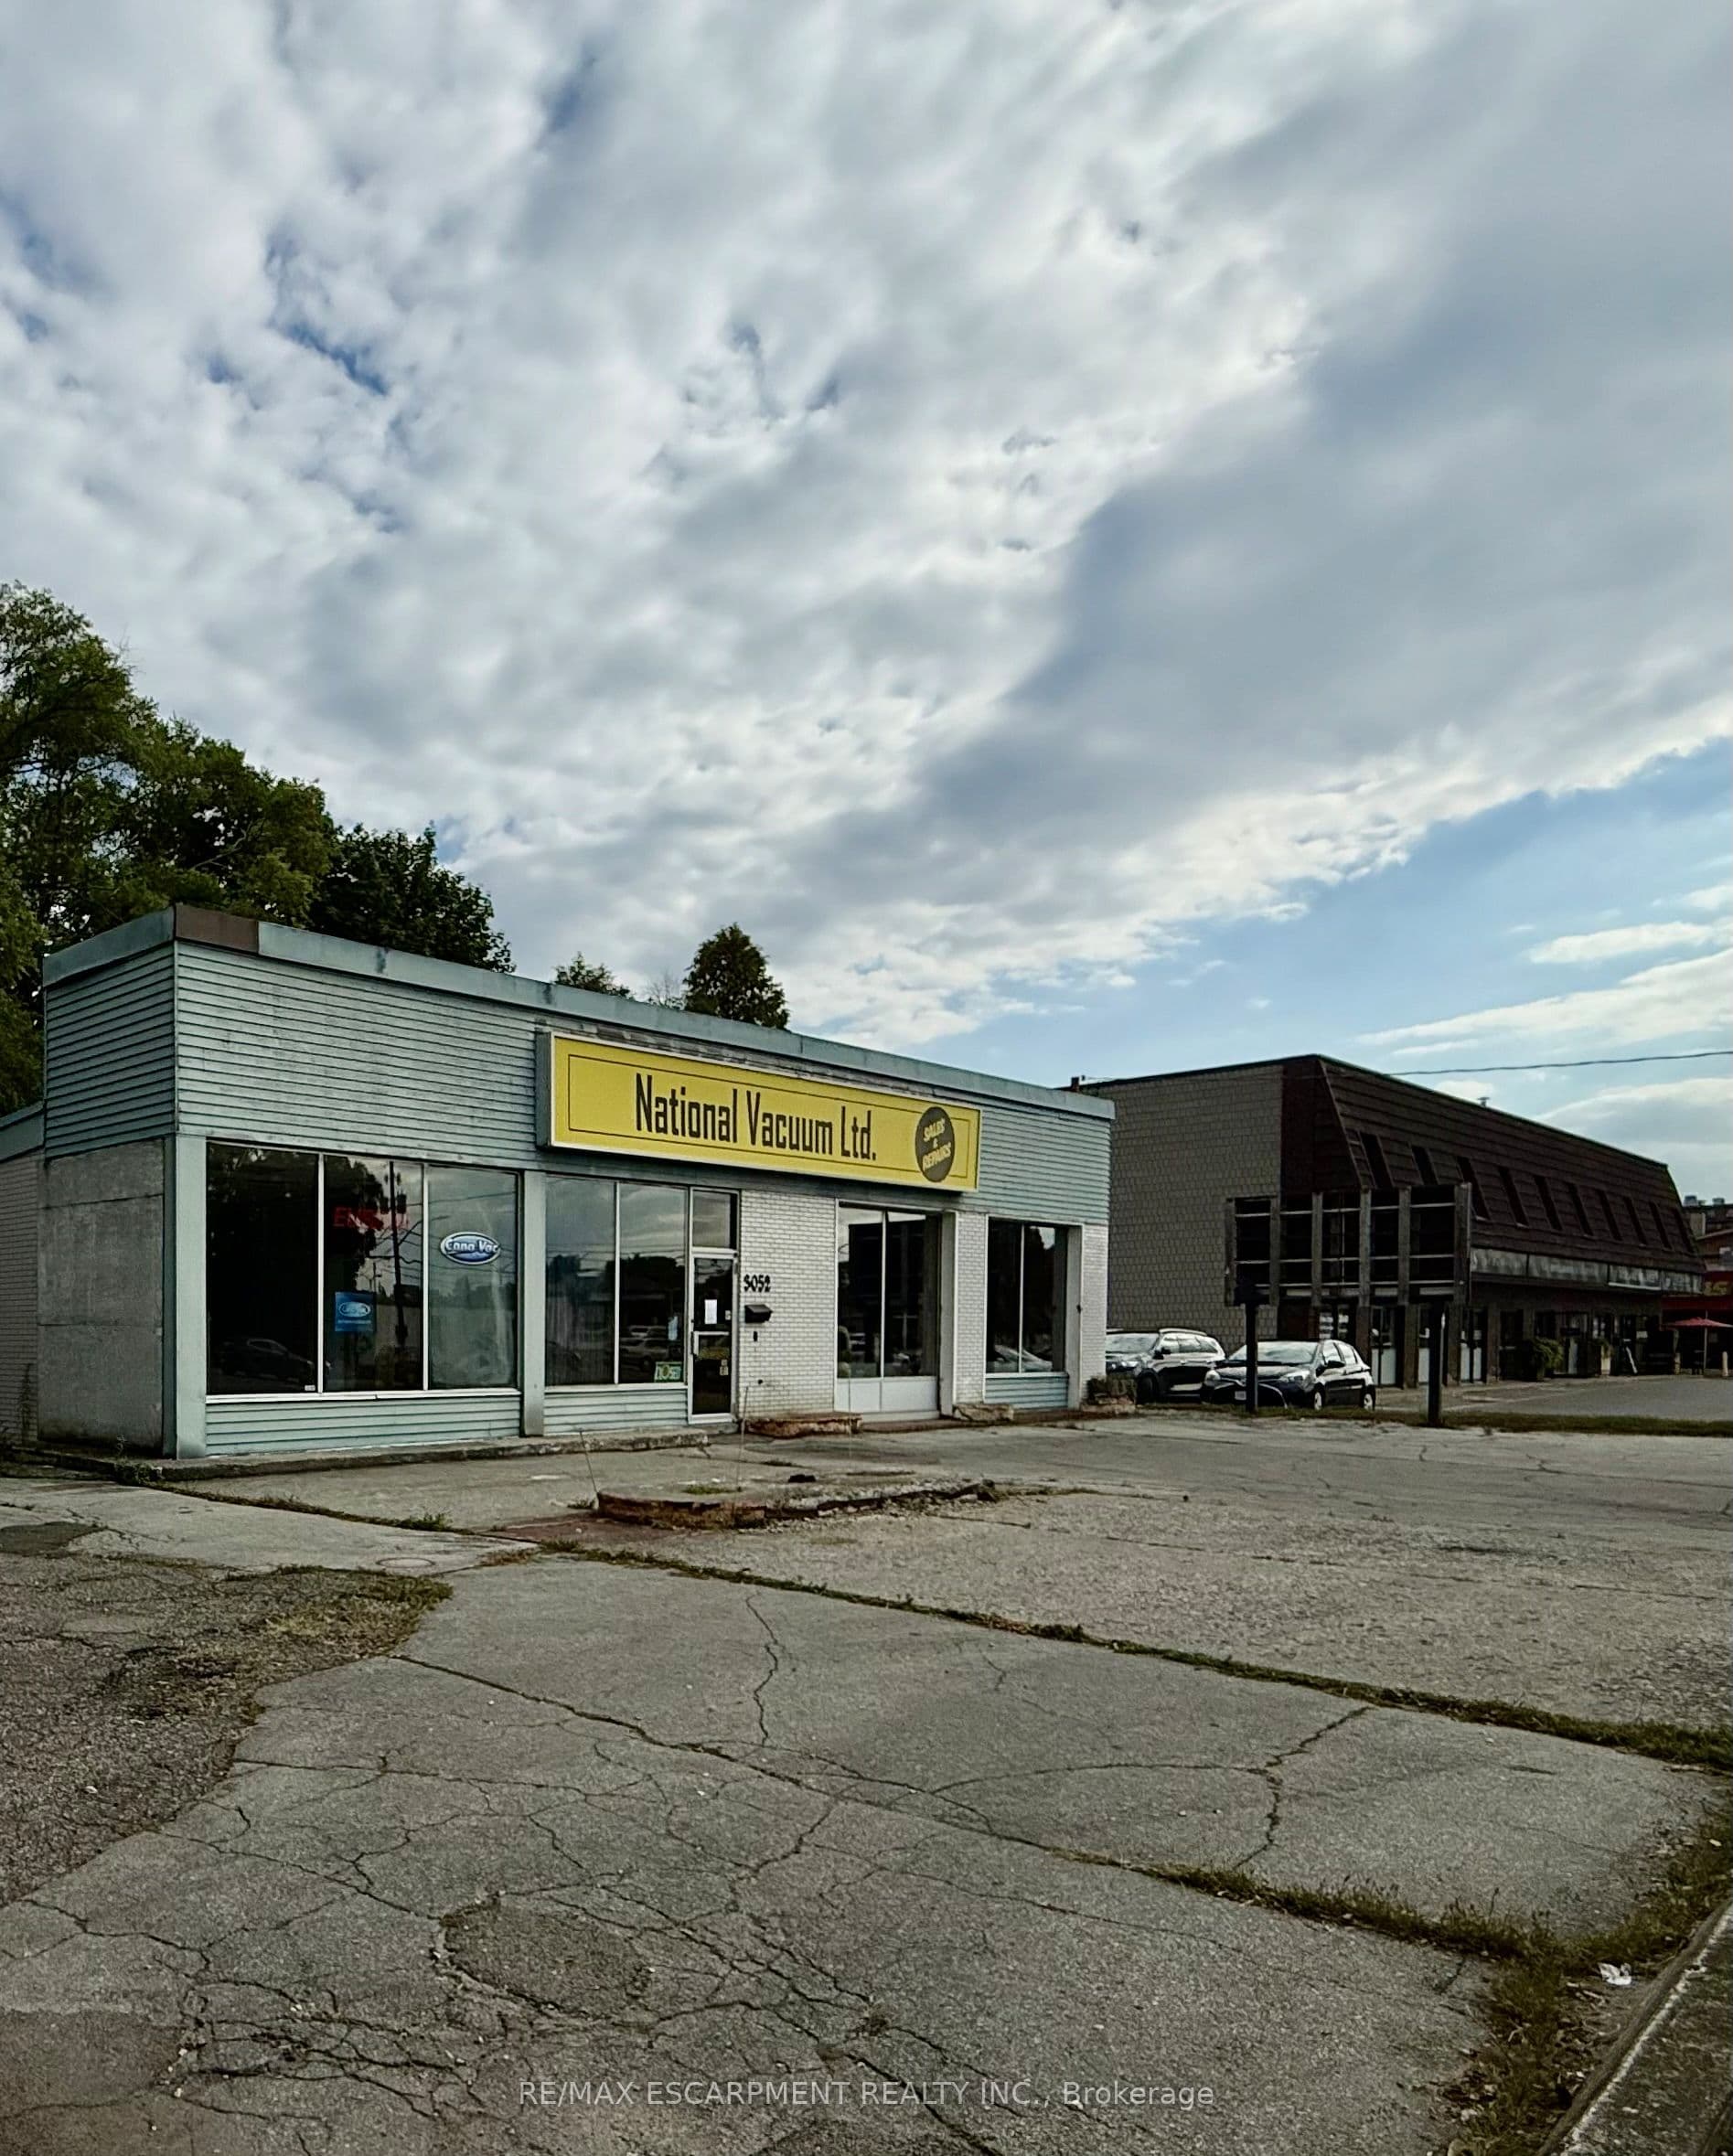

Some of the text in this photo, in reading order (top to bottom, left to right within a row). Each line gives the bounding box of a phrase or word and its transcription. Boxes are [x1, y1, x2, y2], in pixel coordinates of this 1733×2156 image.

[636, 1073, 877, 1161] National Vacuum Ltd.
